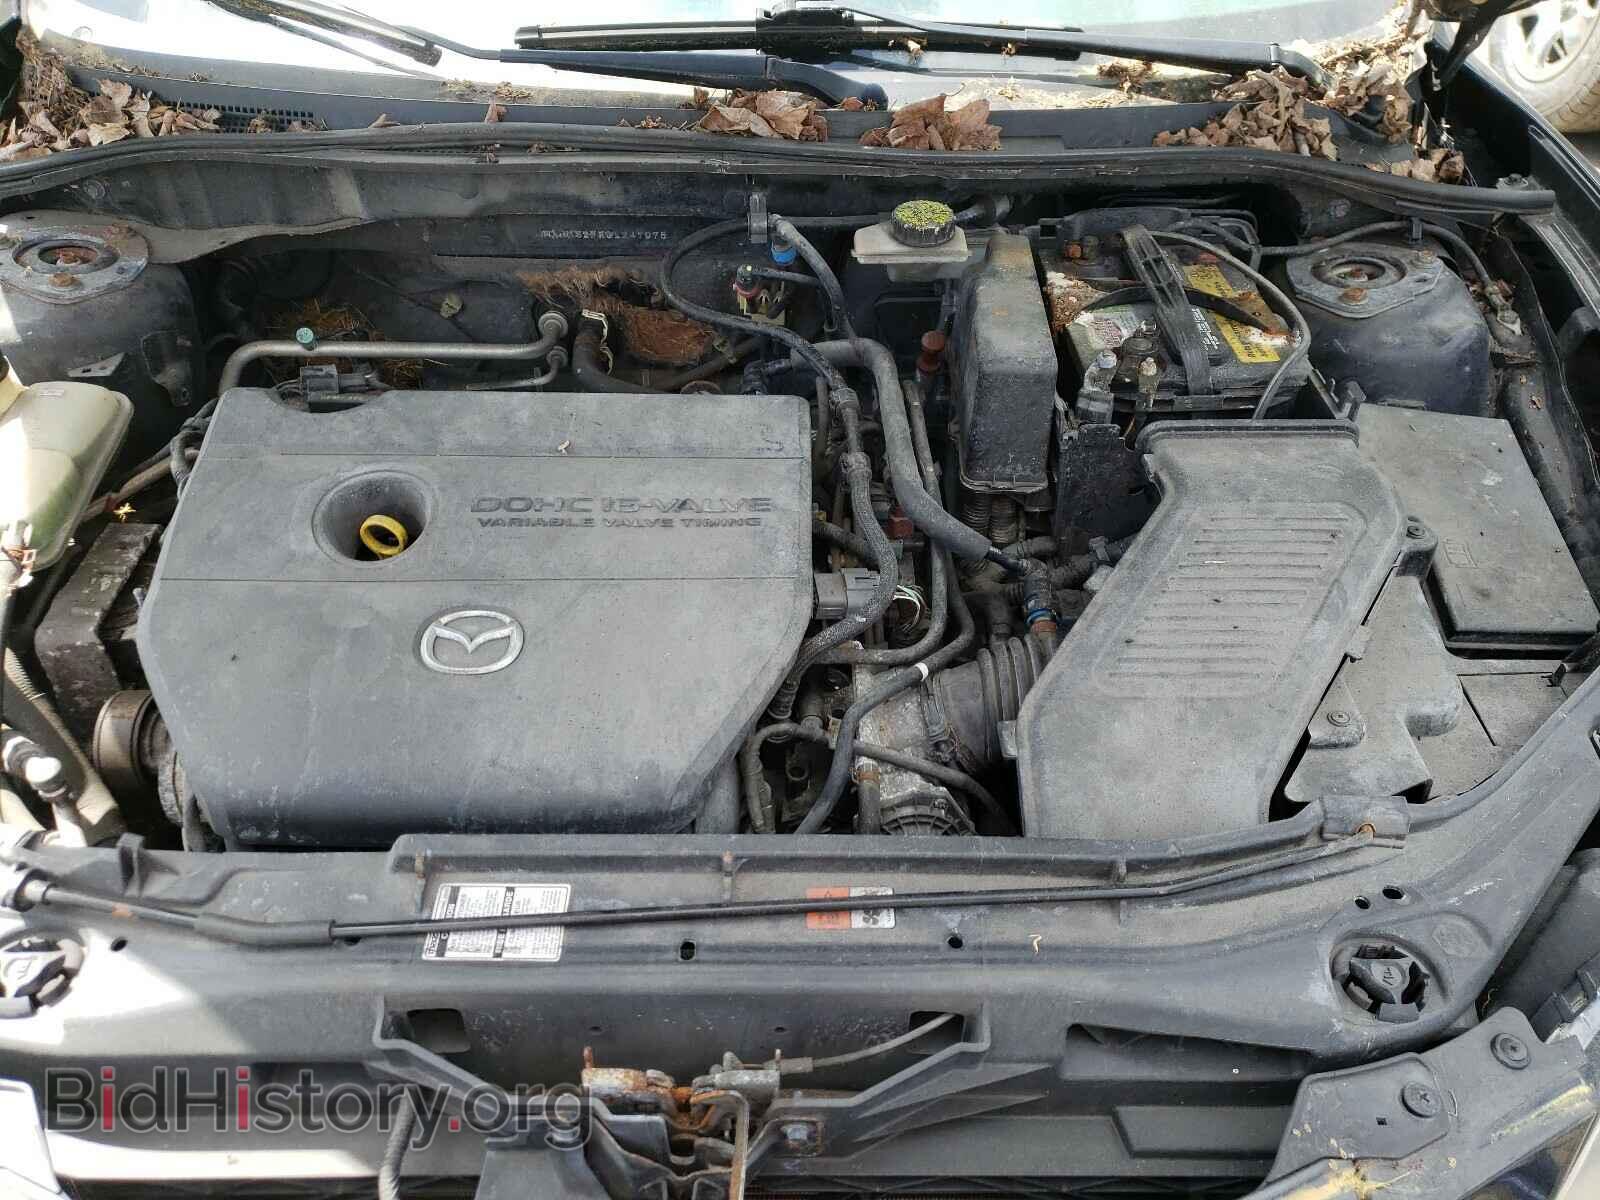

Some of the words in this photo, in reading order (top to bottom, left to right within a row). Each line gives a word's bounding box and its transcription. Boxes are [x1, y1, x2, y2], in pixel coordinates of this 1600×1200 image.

[470, 496, 593, 513] DOHC
[477, 517, 595, 528] VARIABLE
[602, 517, 674, 528] VALVE
[681, 516, 762, 528] TIMING
